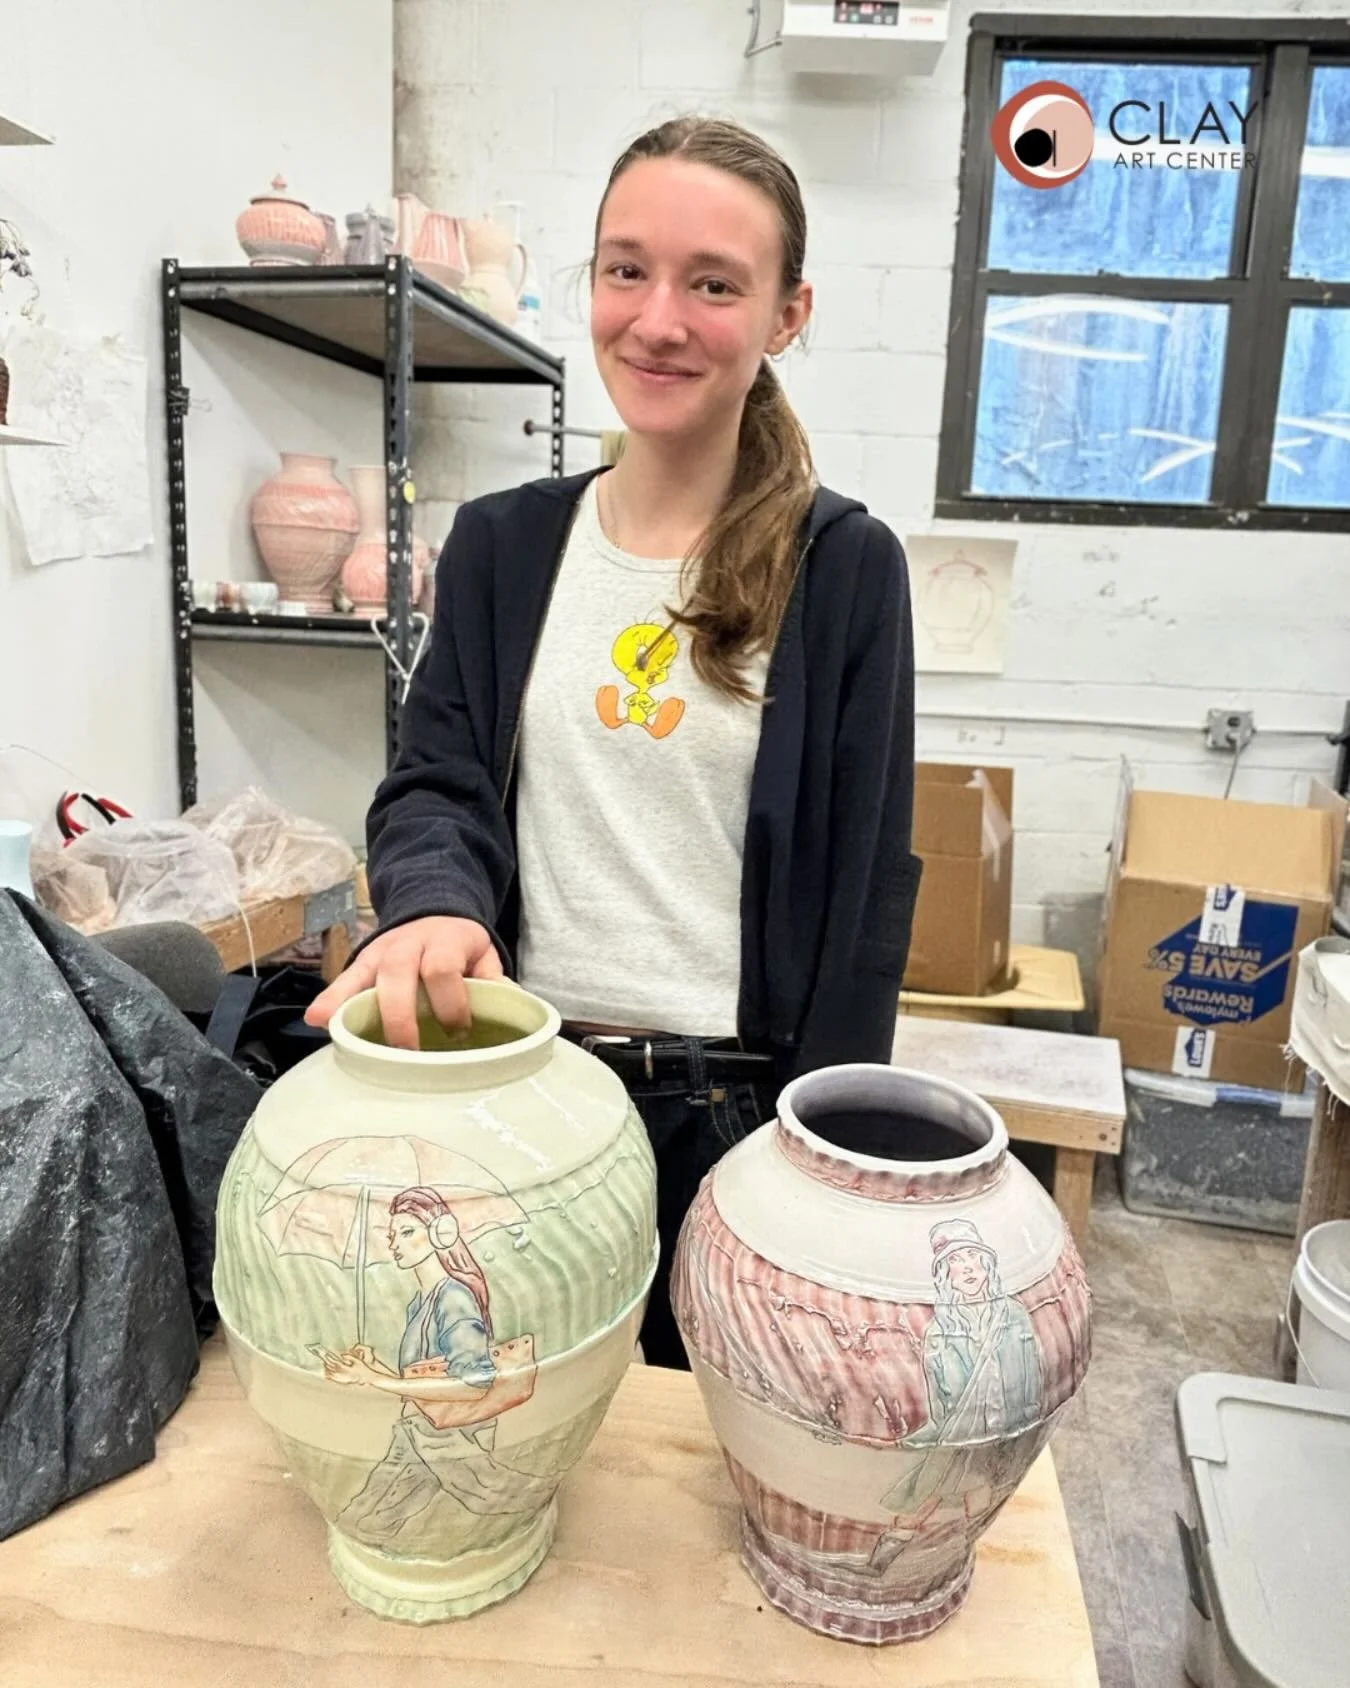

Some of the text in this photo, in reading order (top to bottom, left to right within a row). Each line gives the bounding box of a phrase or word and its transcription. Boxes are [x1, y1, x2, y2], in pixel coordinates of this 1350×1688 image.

[1147, 948, 1260, 983] SAVE 5%
[1219, 947, 1262, 962] EVERY
[1164, 984, 1254, 1013] Rewards
